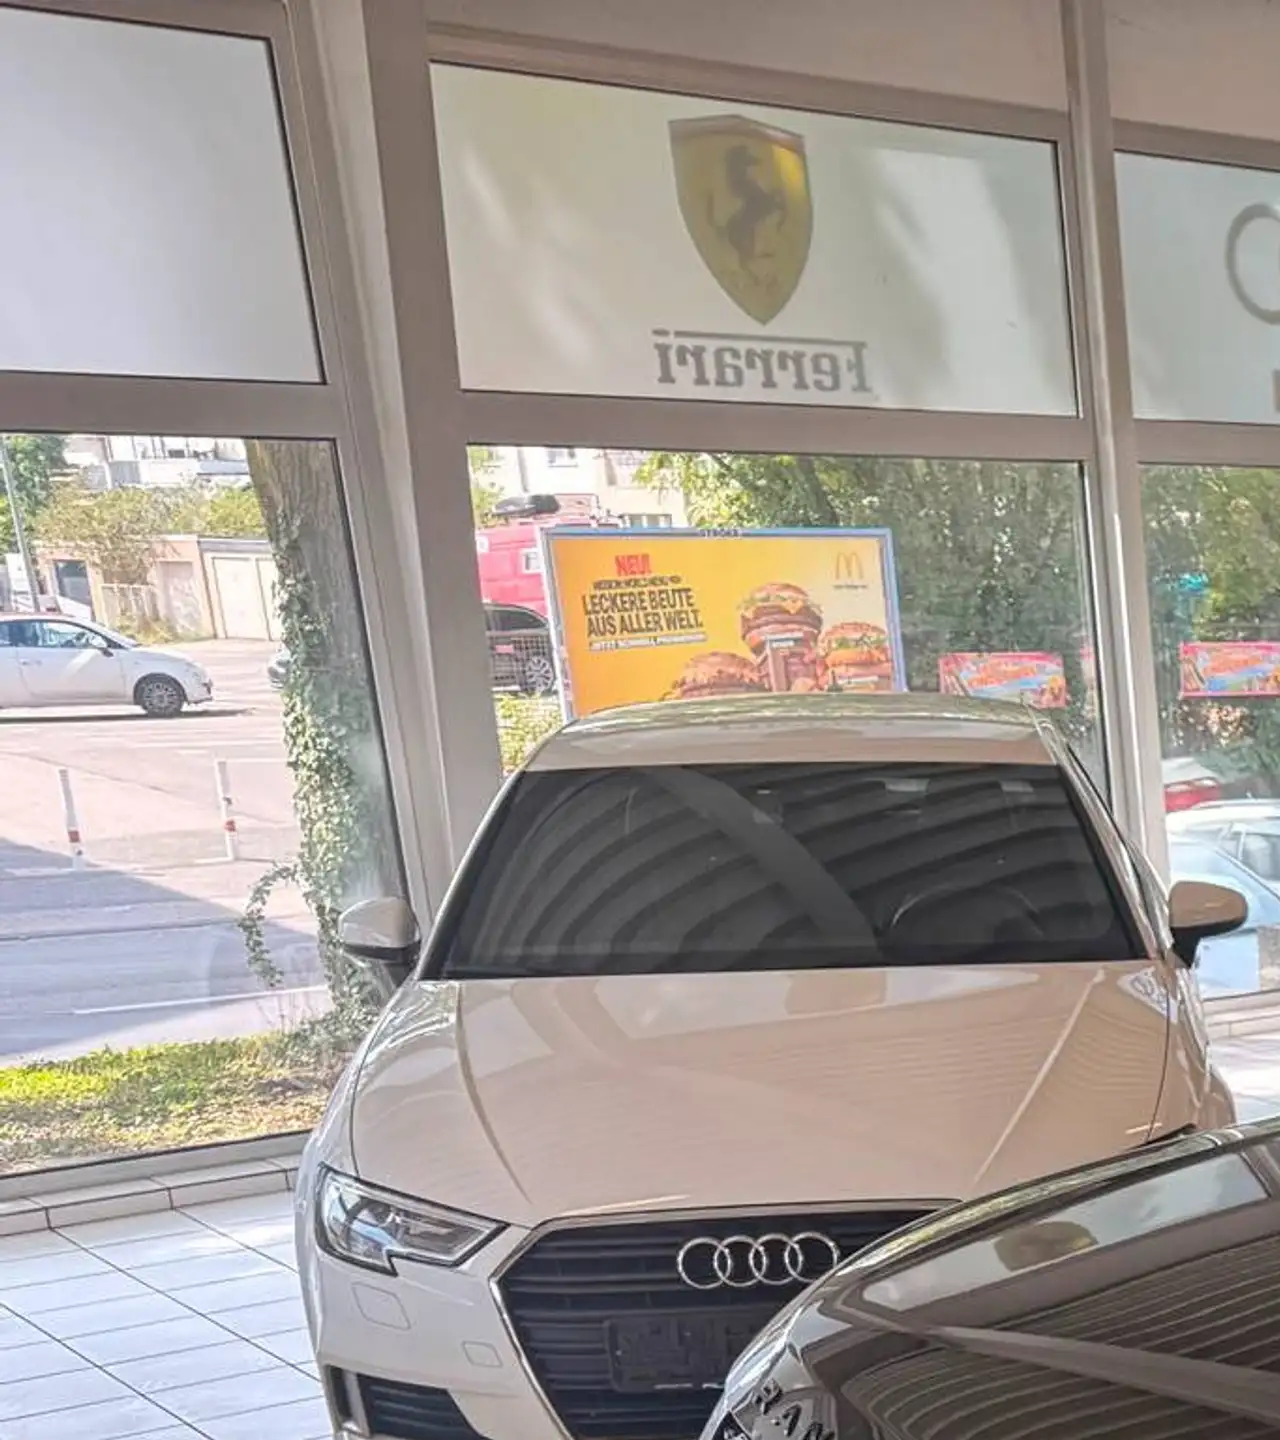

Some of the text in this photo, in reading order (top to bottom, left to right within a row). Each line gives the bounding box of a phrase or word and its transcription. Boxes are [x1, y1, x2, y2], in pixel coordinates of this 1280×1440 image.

[615, 553, 652, 576] NEU!
[582, 588, 694, 616] LECKERE BEUTE
[587, 614, 617, 638] AUS
[620, 611, 664, 634] ALLER
